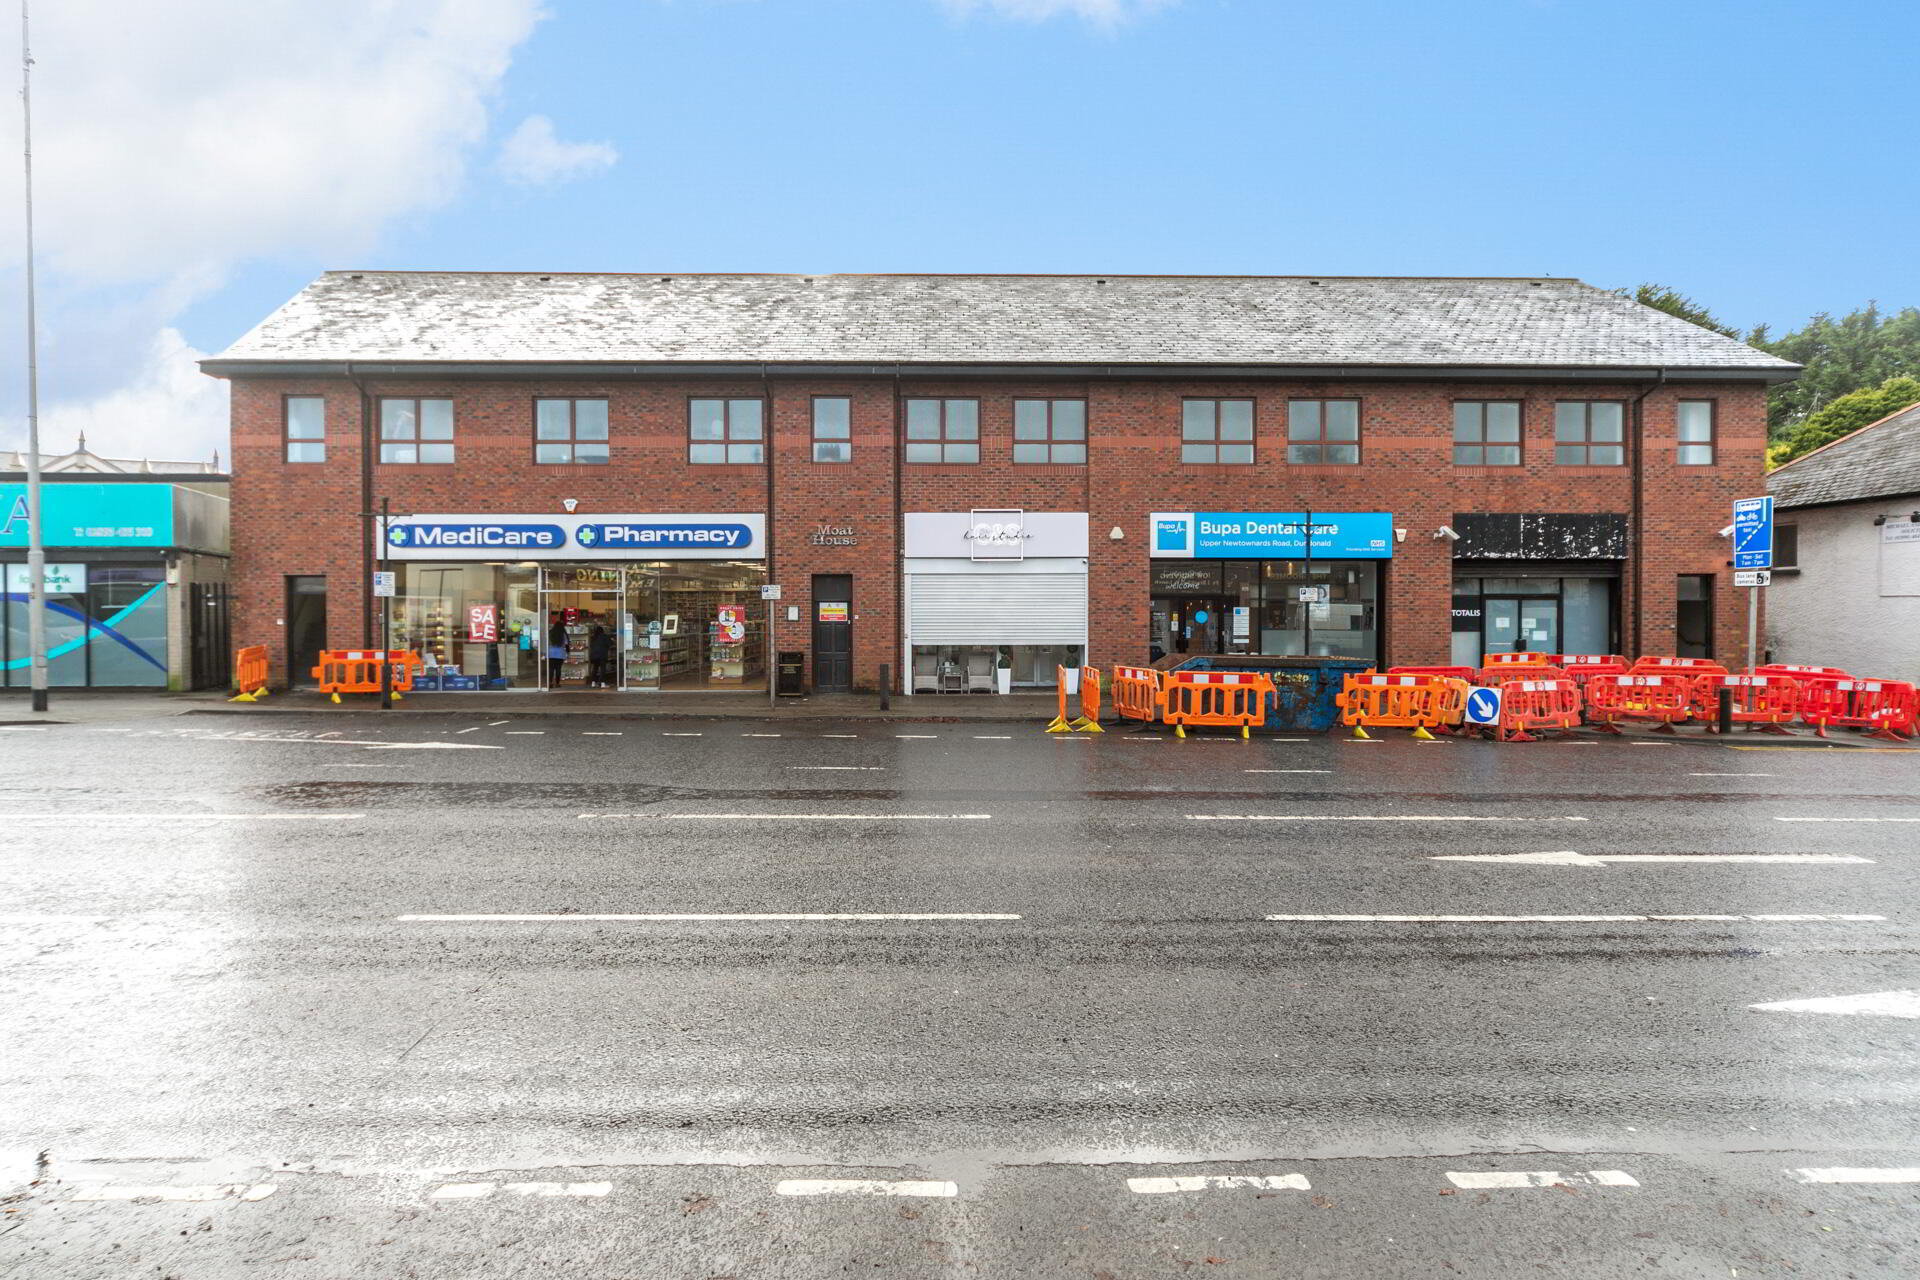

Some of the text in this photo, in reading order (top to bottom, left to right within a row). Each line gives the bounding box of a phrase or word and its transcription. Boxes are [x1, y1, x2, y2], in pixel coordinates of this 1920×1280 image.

[817, 524, 854, 536] Moat
[992, 528, 1035, 542] studio
[1200, 522, 1241, 536] Bupa
[1246, 522, 1297, 535] Dental
[414, 526, 740, 546] MediCare Pharmacy
[812, 534, 858, 546] House
[1200, 540, 1223, 548] Upper
[1452, 609, 1481, 617] TOTALIS
